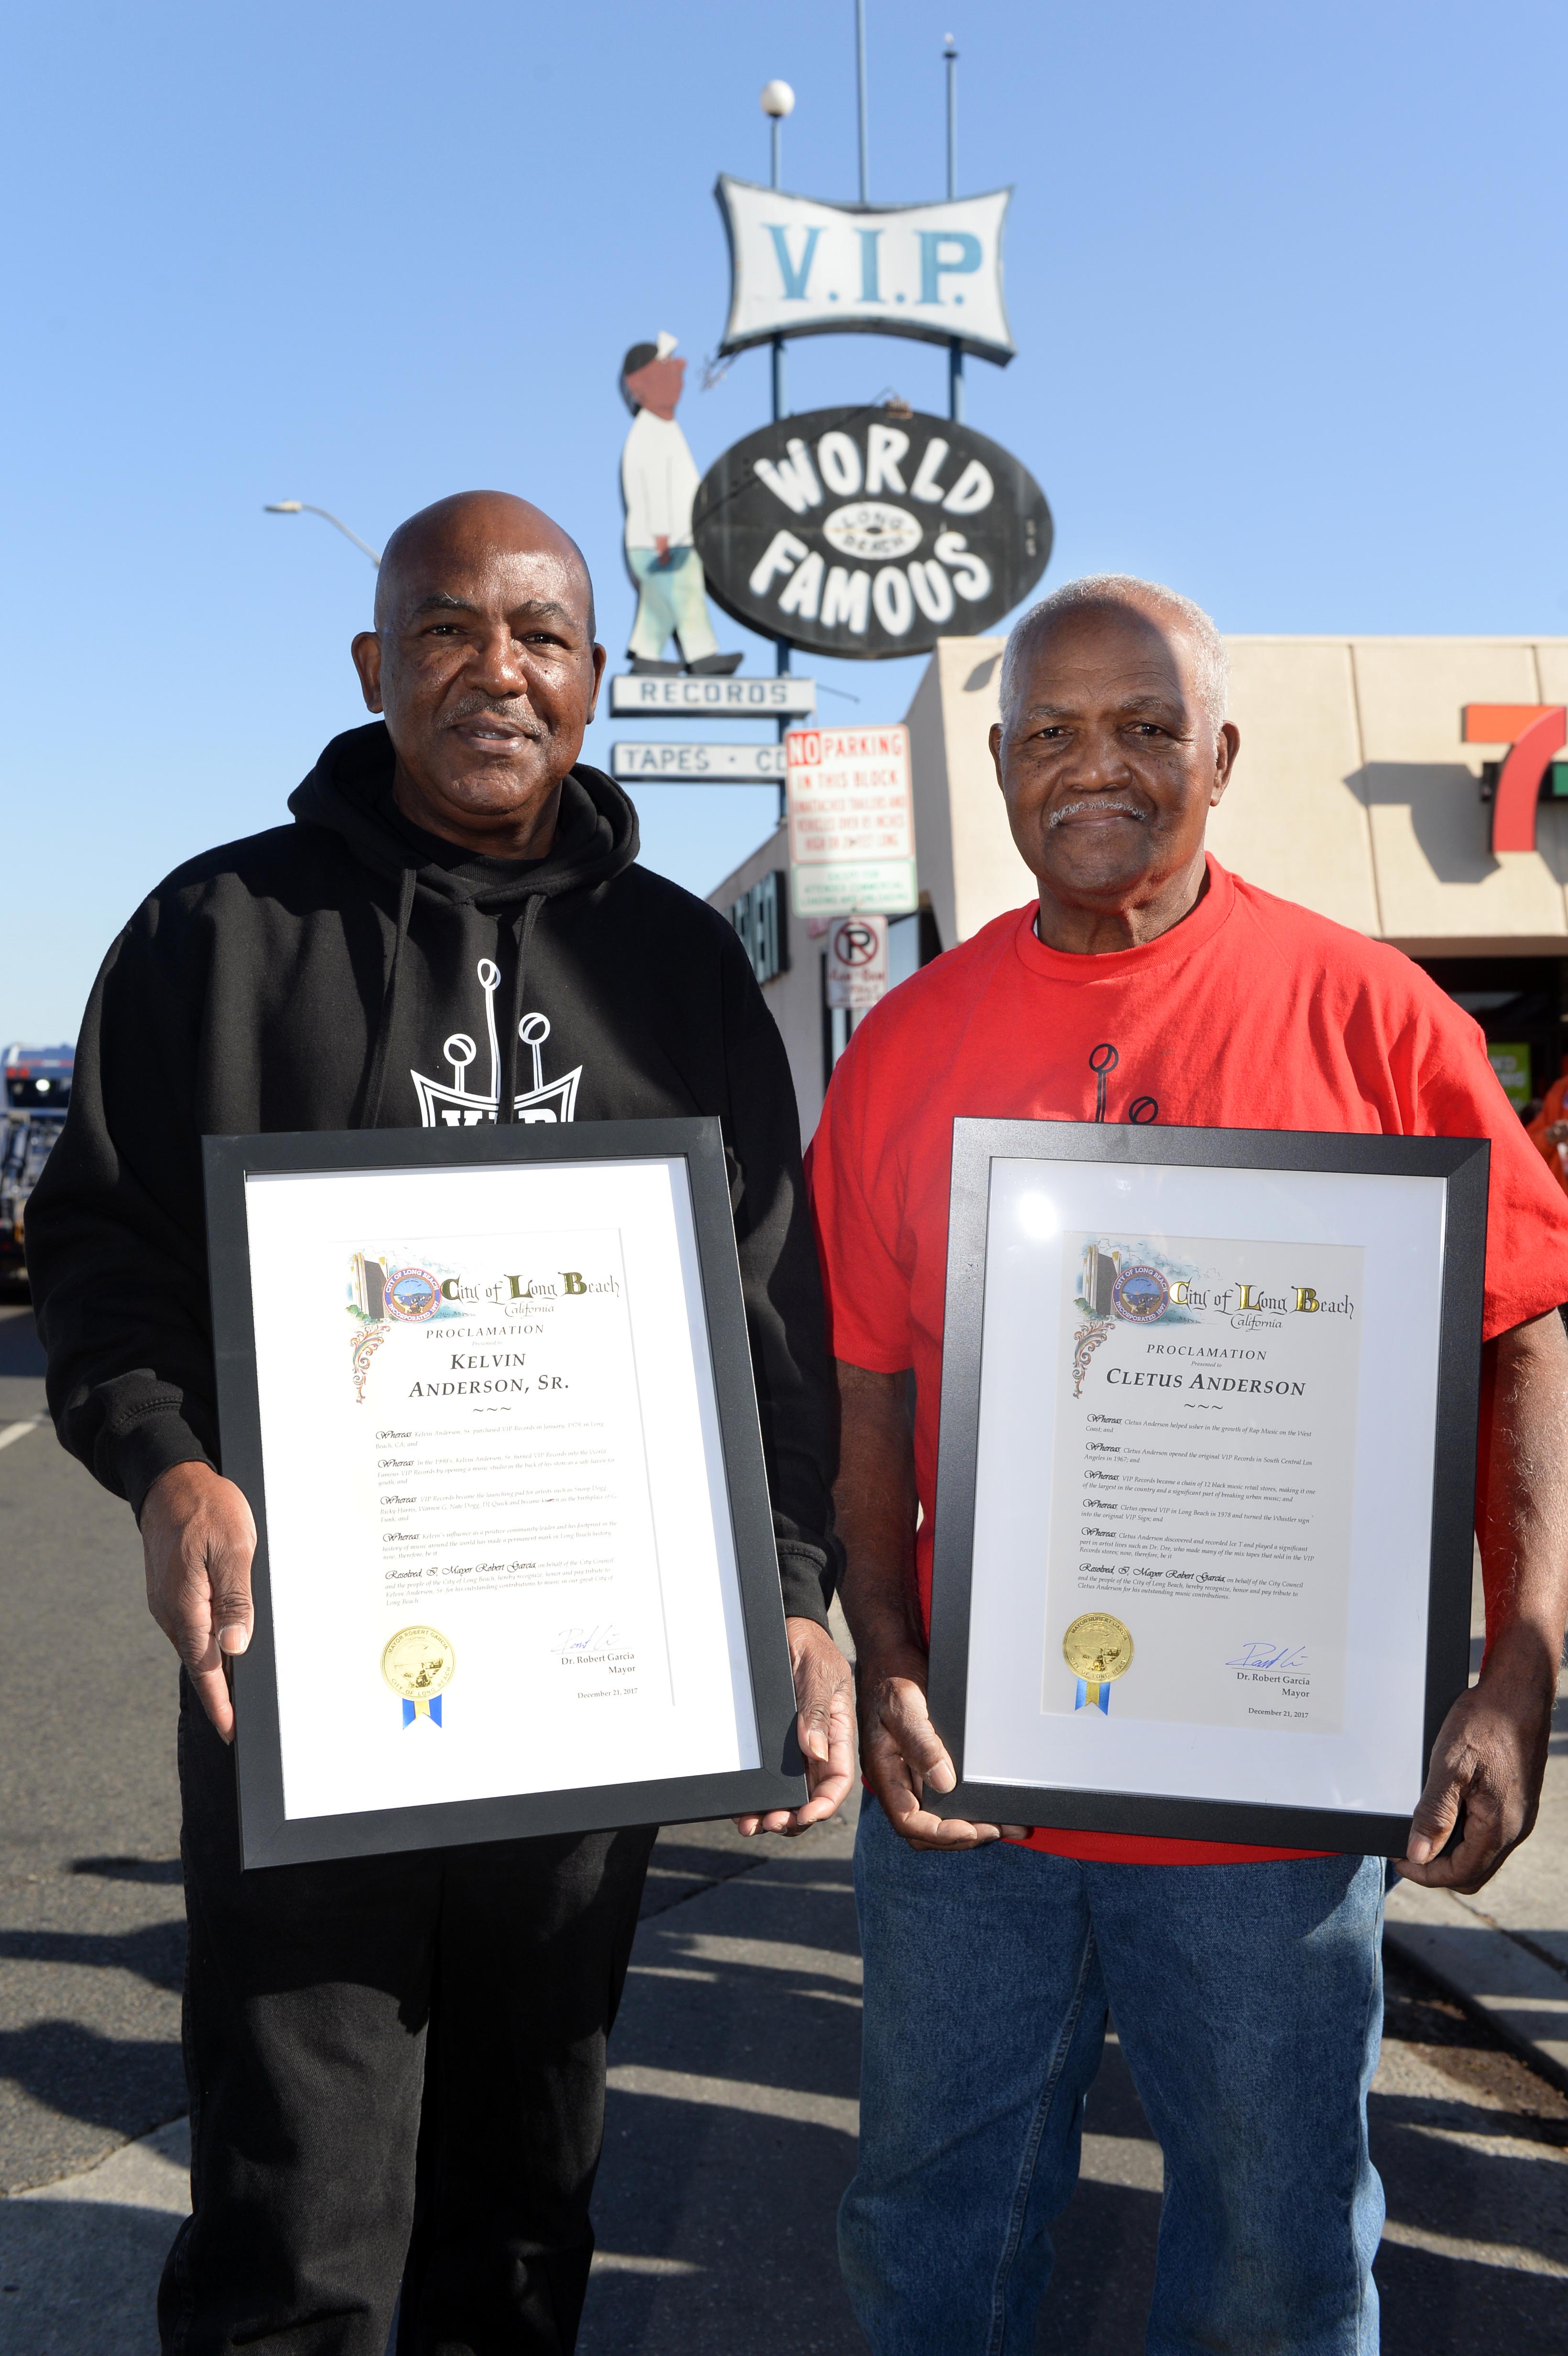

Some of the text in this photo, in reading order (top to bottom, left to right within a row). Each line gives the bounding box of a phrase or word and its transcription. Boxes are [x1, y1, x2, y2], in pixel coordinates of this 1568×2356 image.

[760, 222, 982, 305] V.I.P.
[753, 424, 994, 514] WORLD
[842, 510, 904, 528] LONG
[749, 530, 991, 636] FAMOUS
[640, 682, 787, 704] RECORDS
[789, 734, 902, 765] NO PARKING
[625, 748, 710, 771] TAPES
[797, 769, 898, 789] IN THIS BLOCK
[1465, 705, 1566, 852] 7
[386, 1279, 395, 1293] CITY
[422, 1272, 439, 1290] BEACH
[440, 1272, 620, 1305] City of Long Beach
[1115, 1275, 1125, 1289] CITY
[1154, 1273, 1168, 1292] BEACH
[1170, 1277, 1354, 1320] City of Long Beach
[388, 1300, 439, 1321] INCORPORATED 1897
[504, 1301, 555, 1319] California
[1116, 1301, 1166, 1321] INCORPORATED 1897
[426, 1324, 544, 1339] PROCLAMATION
[1230, 1313, 1282, 1332] California
[450, 1353, 526, 1370] KELVIN
[1146, 1344, 1267, 1361] PROCLAMATION
[1106, 1368, 1307, 1396] CLETUS ANDERSON
[1169, 1421, 1188, 1430] helped
[1249, 1427, 1260, 1435] Rap
[1083, 1453, 1105, 1462] Angeles
[1234, 1577, 1252, 1586] behalf
[1268, 1580, 1281, 1588] City
[1141, 1588, 1174, 1597] outstanding
[1071, 1616, 1128, 1641] MAYOR ROBERT GARCIA
[388, 1629, 448, 1654] MAYOR ROBERT GARCIA
[577, 1655, 605, 1664] Robert
[607, 1652, 634, 1661] Garcia
[1070, 1657, 1081, 1669] CITY
[1112, 1657, 1127, 1675] BEACH
[609, 1666, 636, 1675] Mayor
[1237, 1672, 1310, 1685] Dr. Robert Garcia
[392, 1679, 403, 1691] CITY
[418, 1687, 436, 1696] LONG
[1282, 1688, 1310, 1699] Mayor
[1248, 1707, 1282, 1716] December
